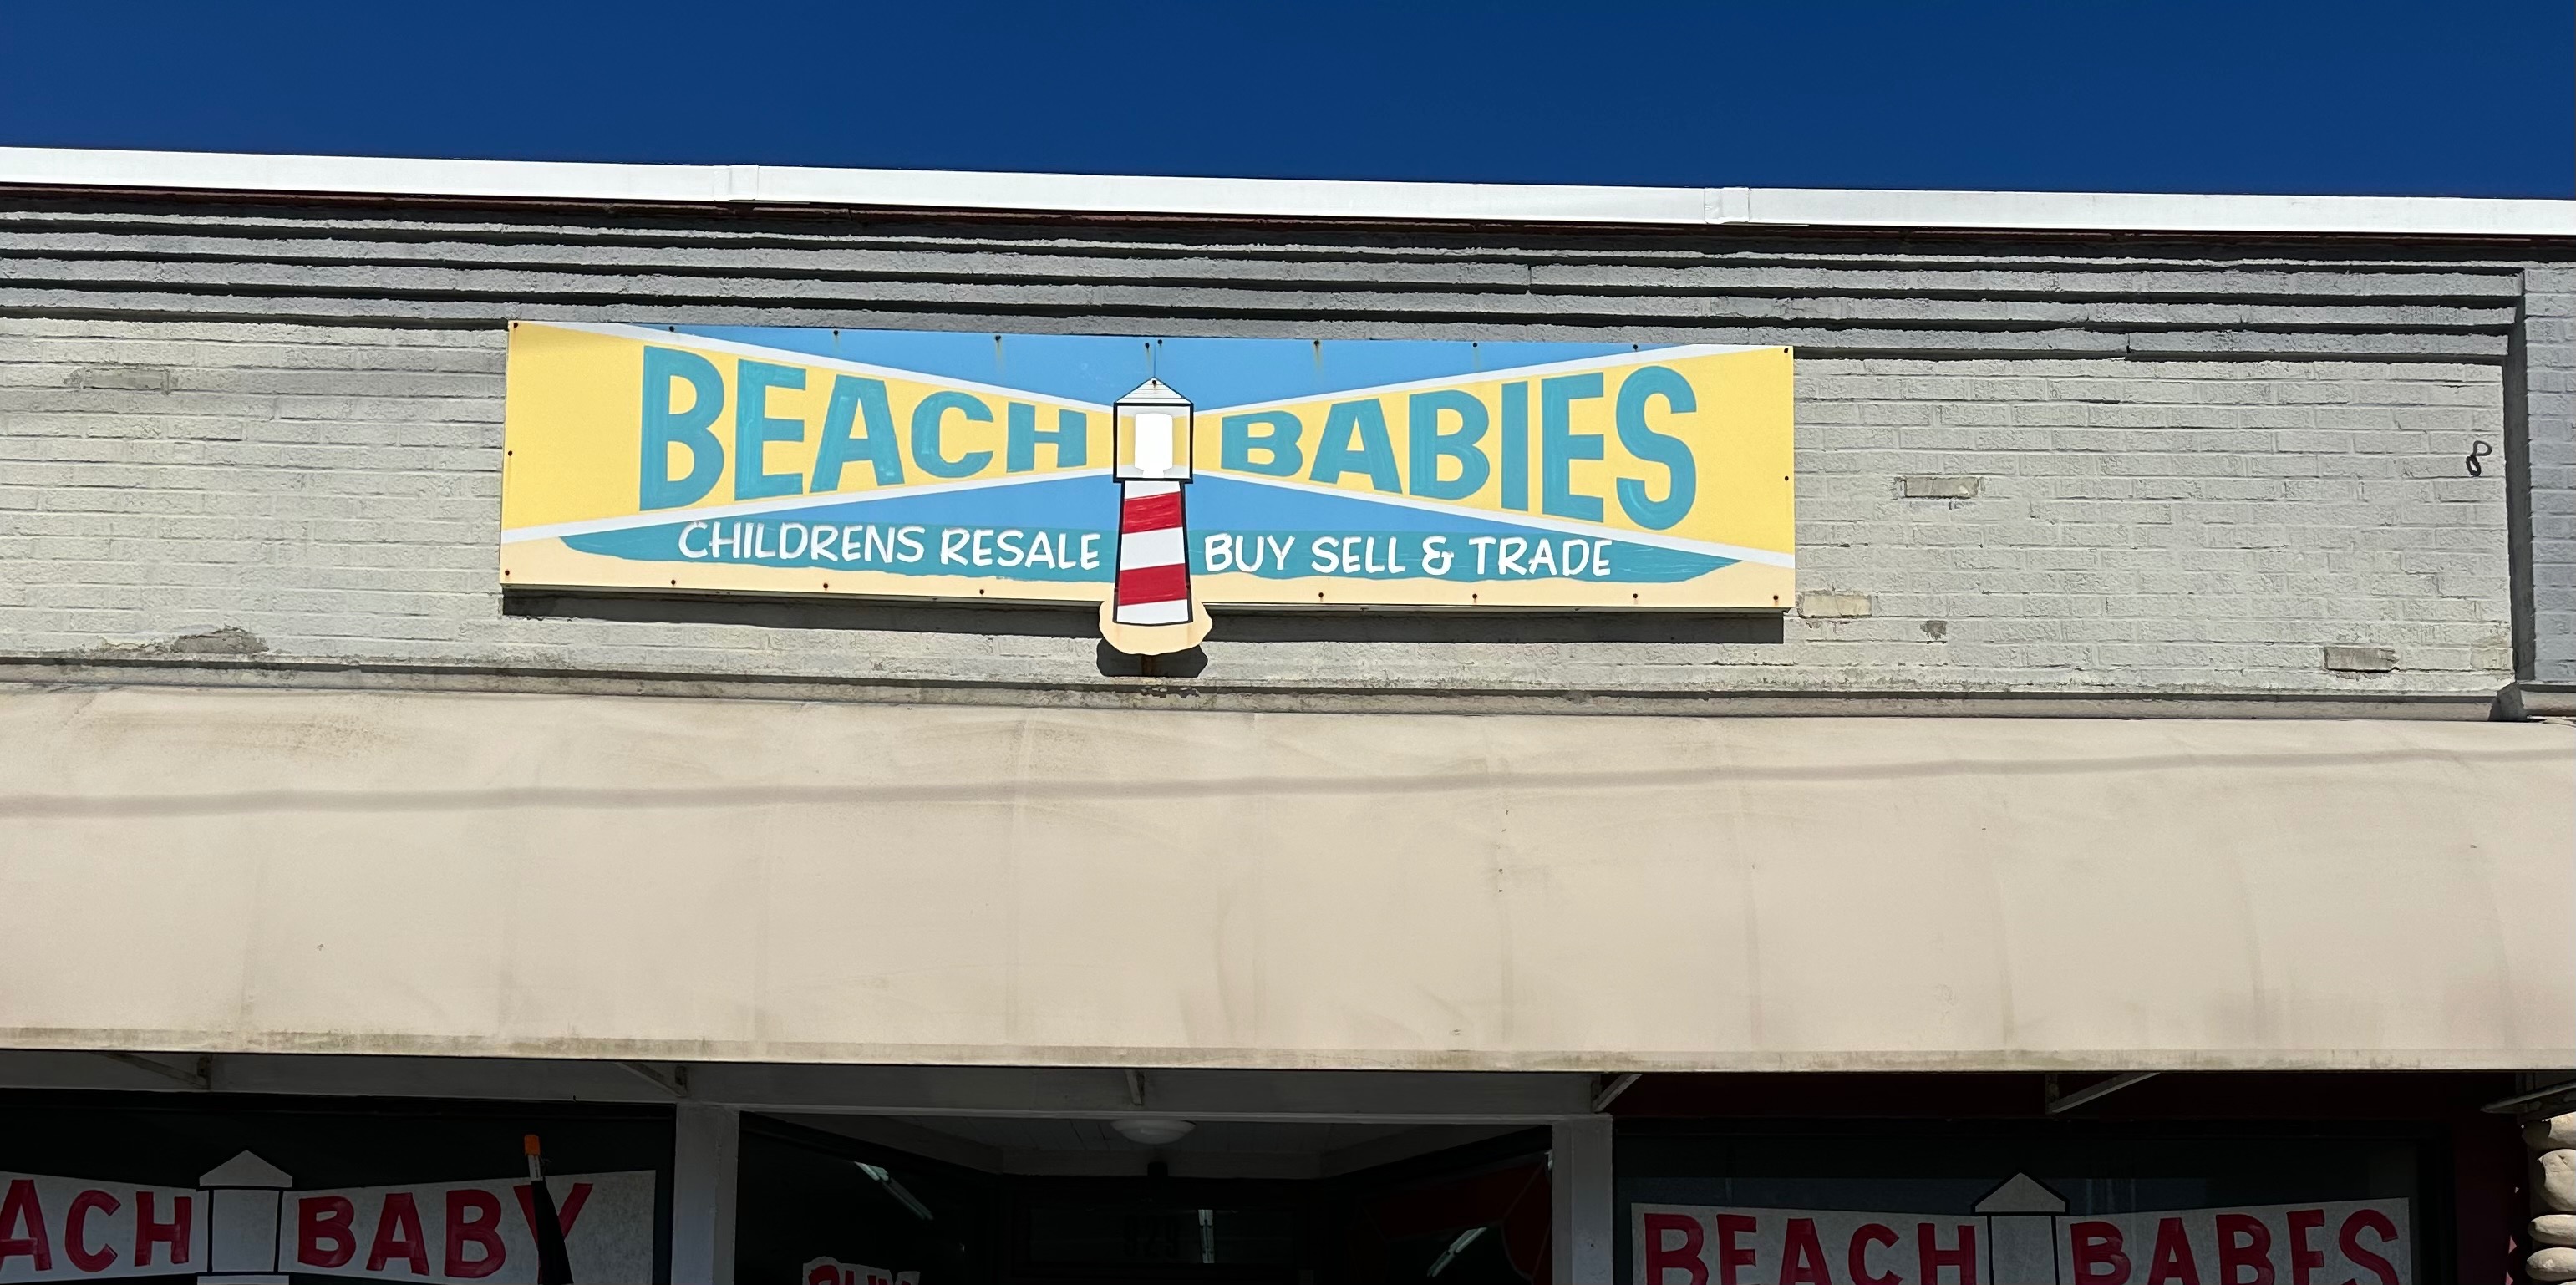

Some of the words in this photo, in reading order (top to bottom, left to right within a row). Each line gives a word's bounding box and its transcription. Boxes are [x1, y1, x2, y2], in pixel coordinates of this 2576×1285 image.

[639, 345, 1088, 511] BEACH
[1220, 365, 1697, 531] BABIES
[678, 520, 927, 564] CHILDRENS
[940, 527, 1102, 571] RESALE
[1204, 532, 1295, 573] BUY
[1311, 536, 1407, 574] SELL
[1422, 536, 1455, 576] &
[1468, 535, 1613, 576] TRADE
